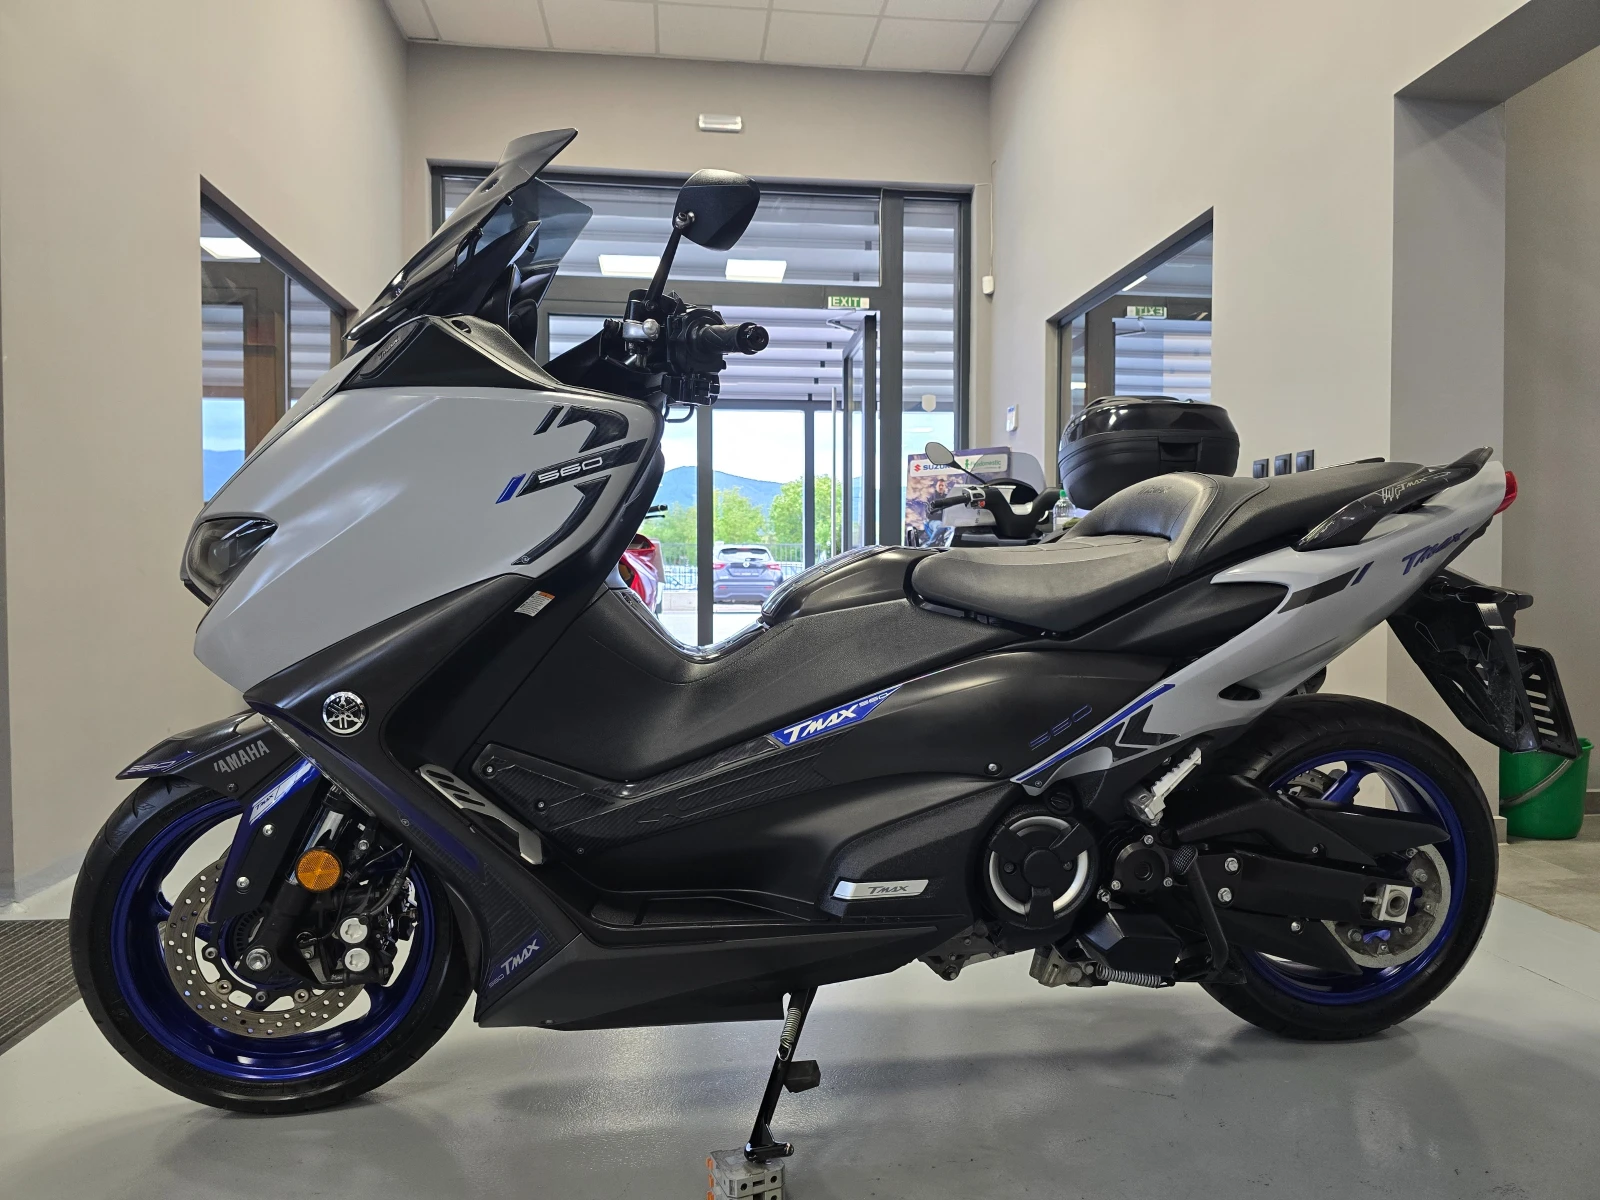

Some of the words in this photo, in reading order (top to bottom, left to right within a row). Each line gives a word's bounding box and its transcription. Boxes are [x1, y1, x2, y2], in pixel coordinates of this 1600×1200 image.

[832, 296, 860, 308] EXIT
[538, 456, 603, 484] 560
[784, 703, 859, 743] TMAX
[1028, 704, 1093, 751] 560
[868, 885, 909, 894] TMAX
[500, 938, 540, 975] TMAX
